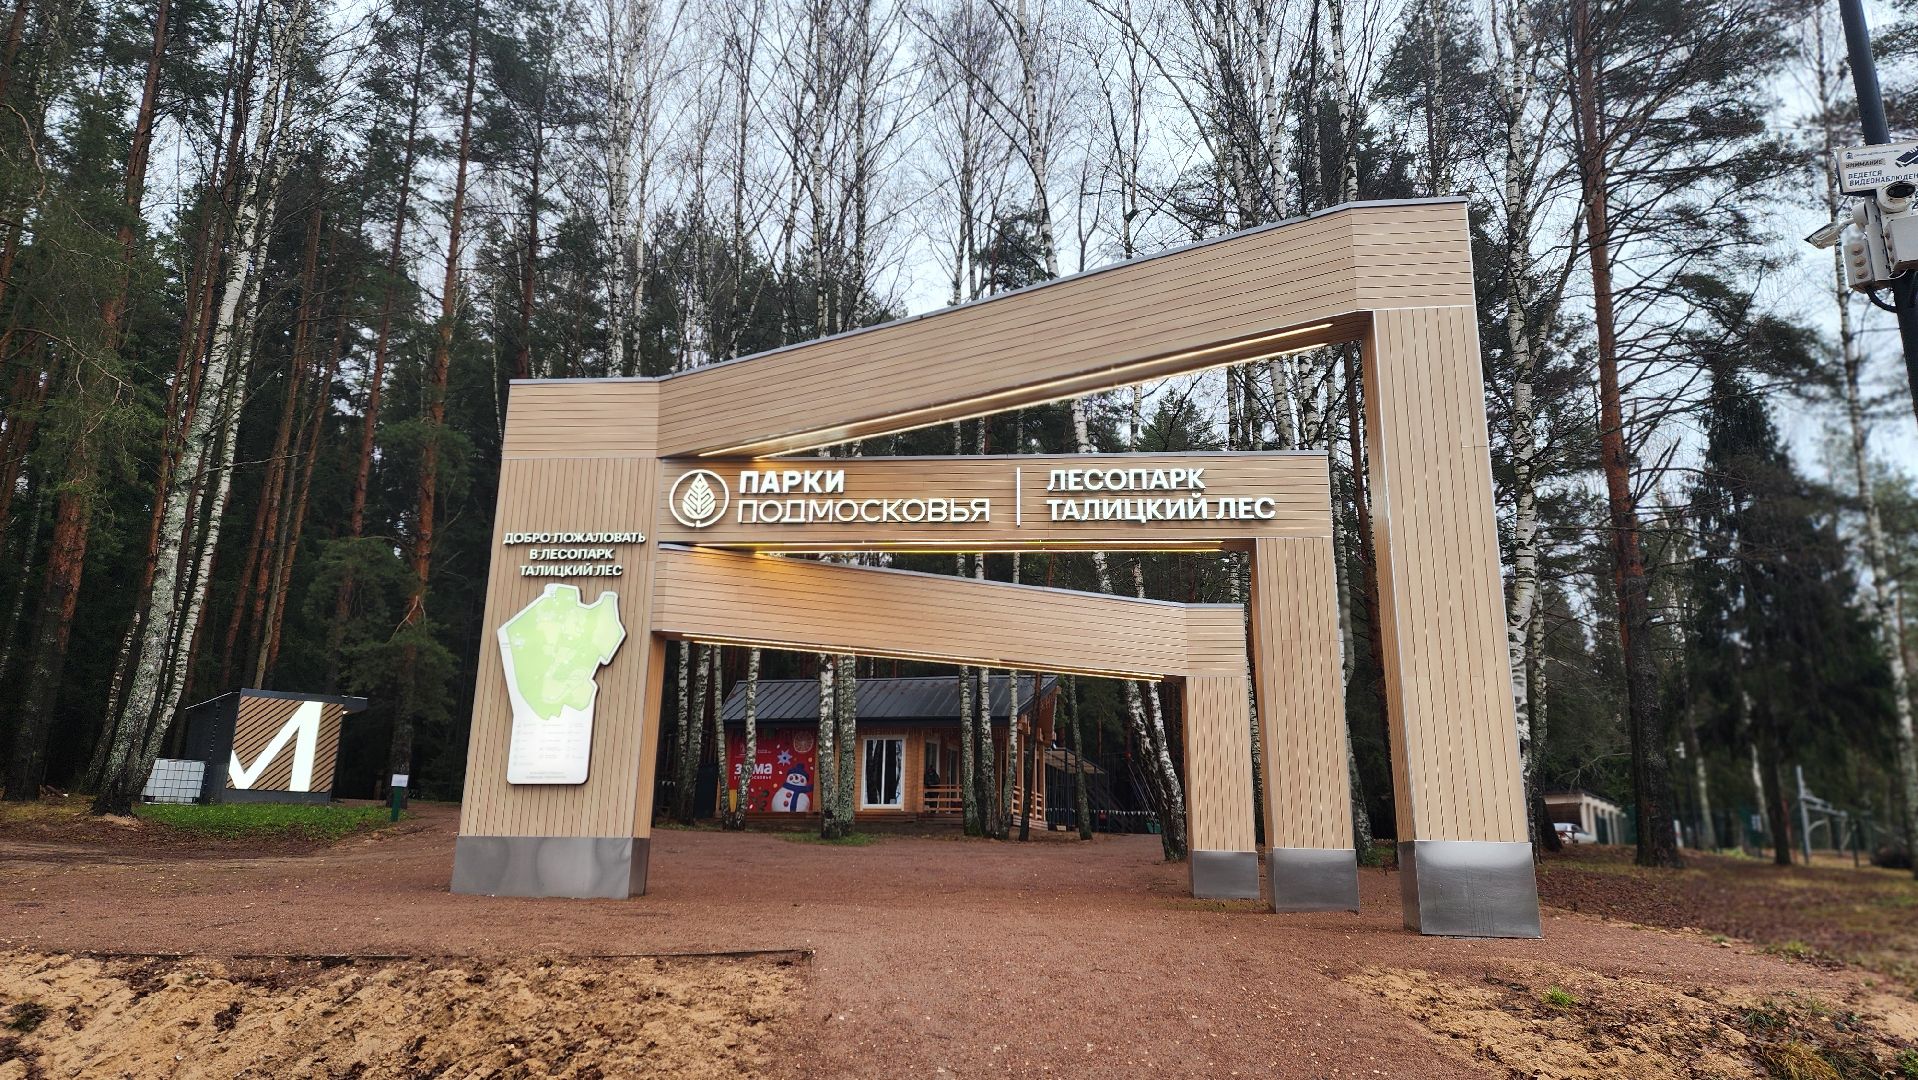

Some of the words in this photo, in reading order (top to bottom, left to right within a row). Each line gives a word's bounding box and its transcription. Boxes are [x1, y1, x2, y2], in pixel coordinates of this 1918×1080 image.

[1848, 170, 1883, 179] ВЕДЕТСЯ
[738, 469, 845, 494] ПАРКИ
[1046, 467, 1207, 491] ЛЕСОПАРК
[737, 497, 990, 523] ПОДМОСКОВЬЯ
[1046, 492, 1208, 523] ТАЛИЦКИЙ
[1215, 496, 1277, 520] ЛЕС
[503, 532, 550, 545] ДОБРО
[553, 532, 646, 544] ПОЖАЛОВАТЬ
[529, 548, 538, 560] В
[540, 548, 614, 560] ЛЕСОПАРК
[520, 562, 593, 577] ТАЛИЦКИЙ
[594, 564, 623, 576] ЛЕС
[734, 763, 773, 775] зма
